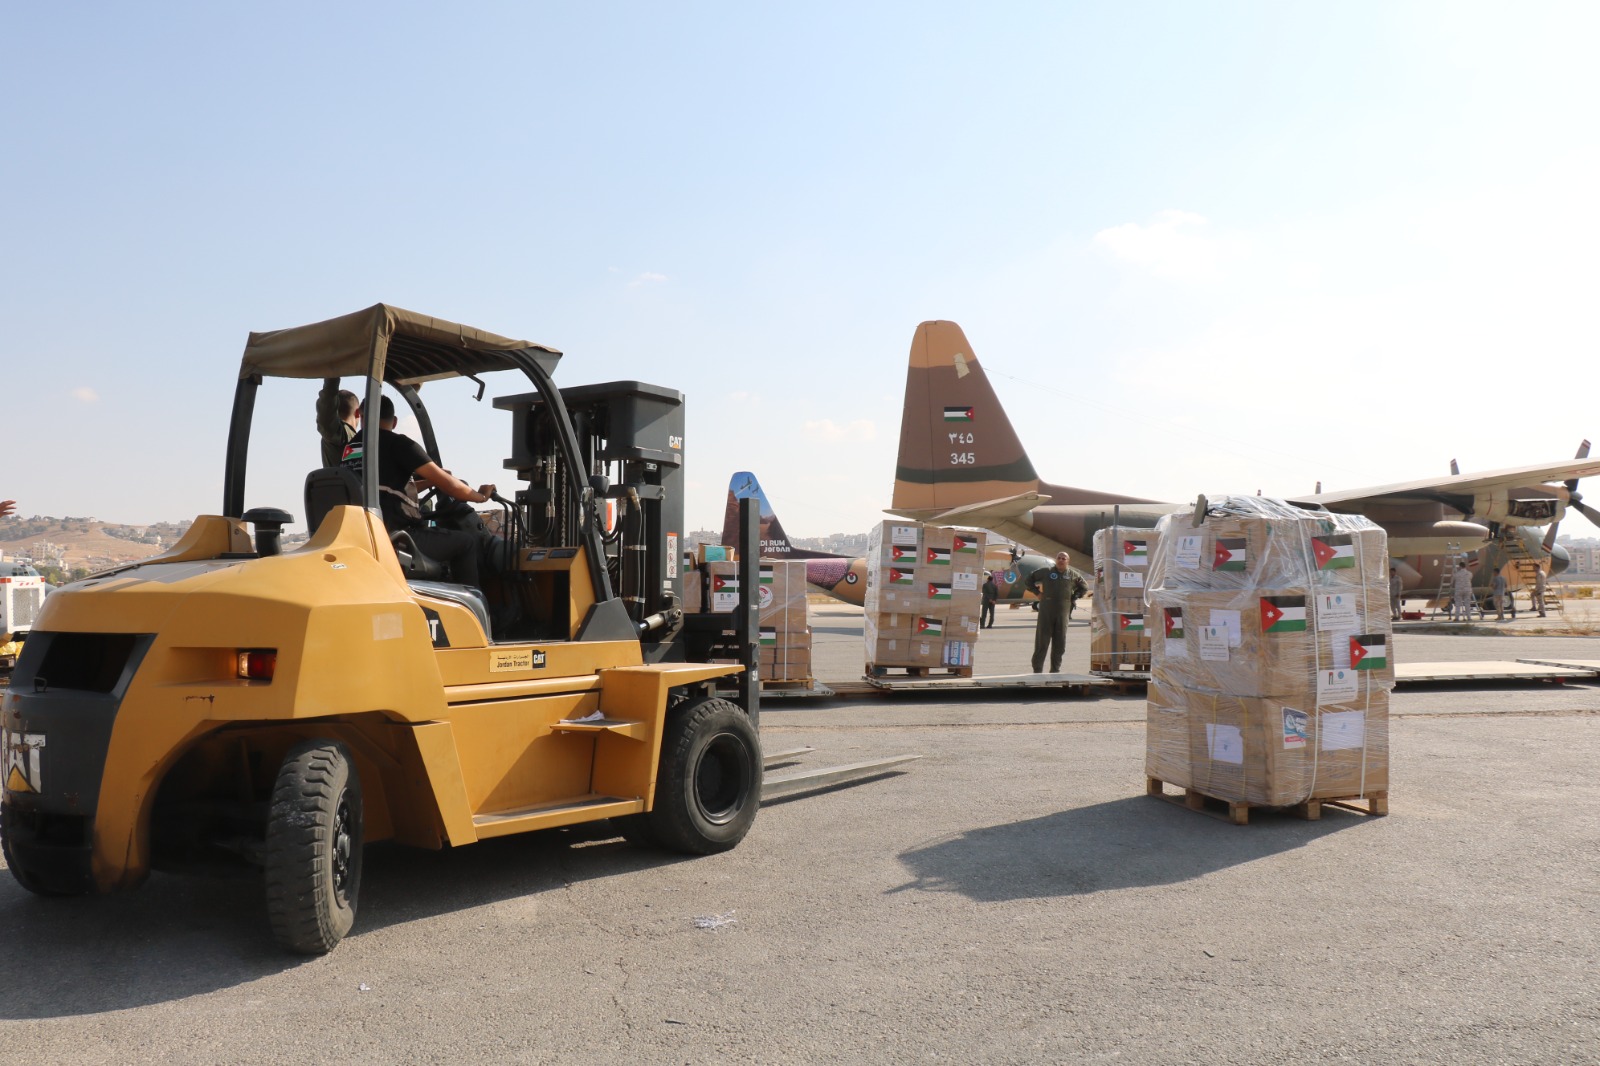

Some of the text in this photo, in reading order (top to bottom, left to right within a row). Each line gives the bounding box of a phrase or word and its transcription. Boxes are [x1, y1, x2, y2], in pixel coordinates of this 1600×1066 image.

[668, 435, 683, 450] CAT
[948, 432, 974, 444] ٣٤٥
[950, 452, 975, 465] 345
[533, 654, 545, 664] CAT
